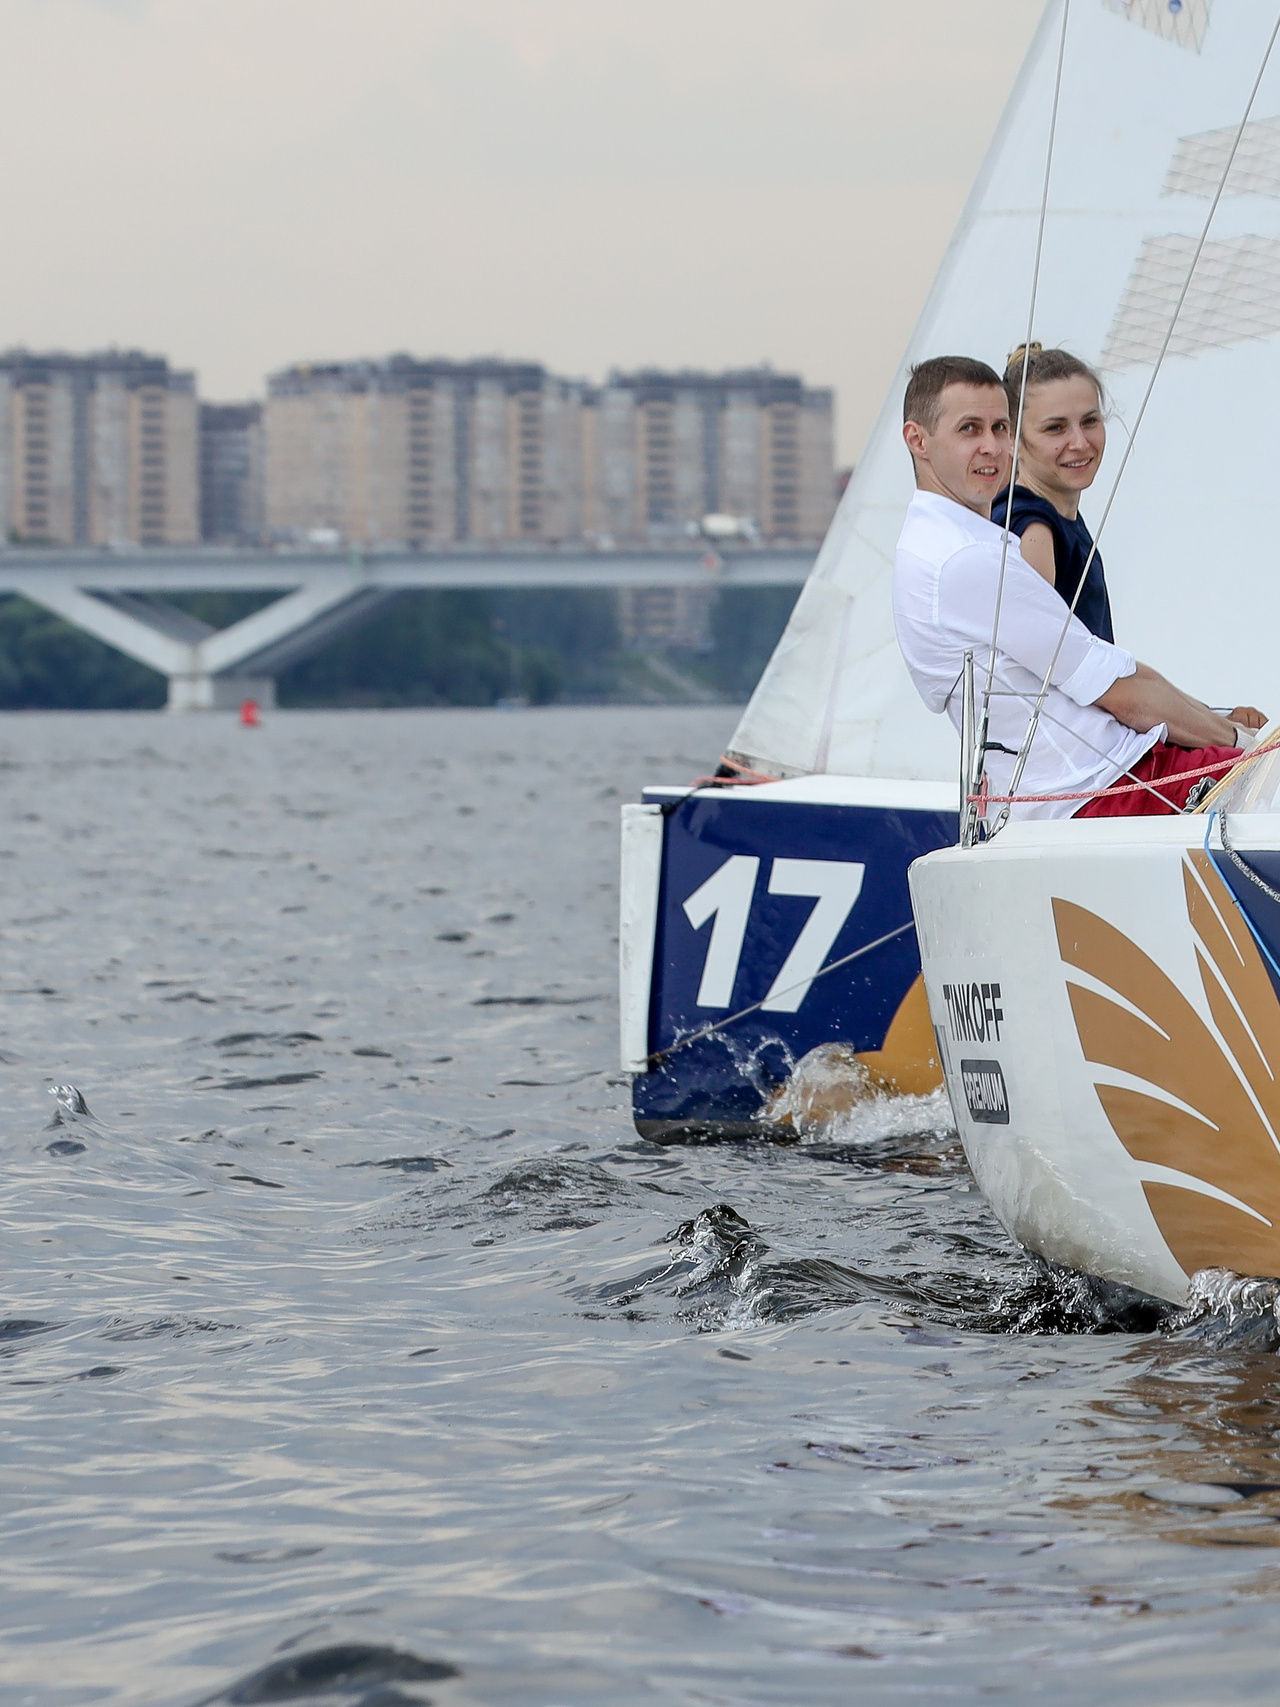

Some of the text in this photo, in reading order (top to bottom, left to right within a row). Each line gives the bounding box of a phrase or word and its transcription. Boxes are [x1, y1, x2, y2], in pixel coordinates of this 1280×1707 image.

[682, 854, 866, 1014] 17
[942, 982, 1004, 1044] TINKOFF
[962, 1072, 1007, 1112] PREMIUM
